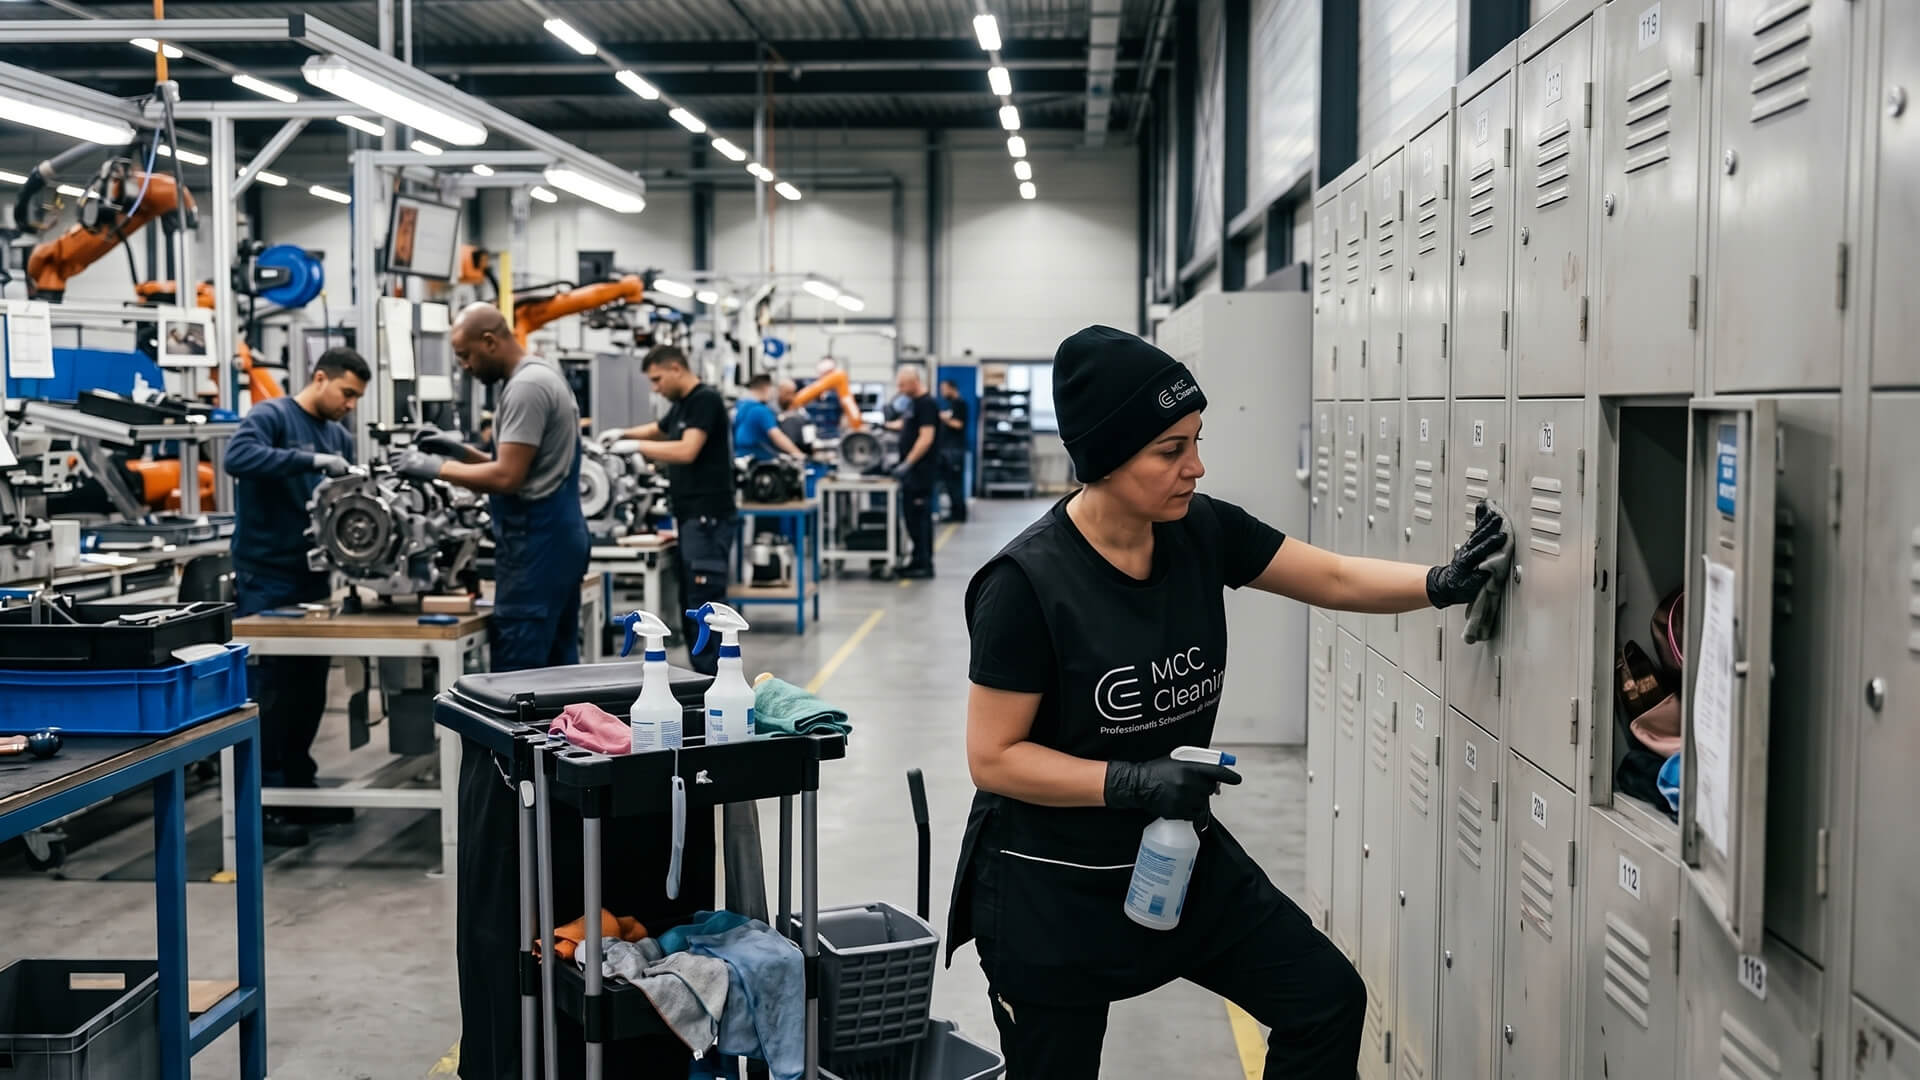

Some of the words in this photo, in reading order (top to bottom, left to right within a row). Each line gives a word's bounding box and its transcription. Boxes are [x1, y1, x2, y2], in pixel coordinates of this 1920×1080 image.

[1642, 13, 1658, 41] 119
[1170, 379, 1188, 393] MCC
[1151, 646, 1205, 684] MCC
[1623, 863, 1637, 891] 112
[1743, 956, 1763, 991] 113
